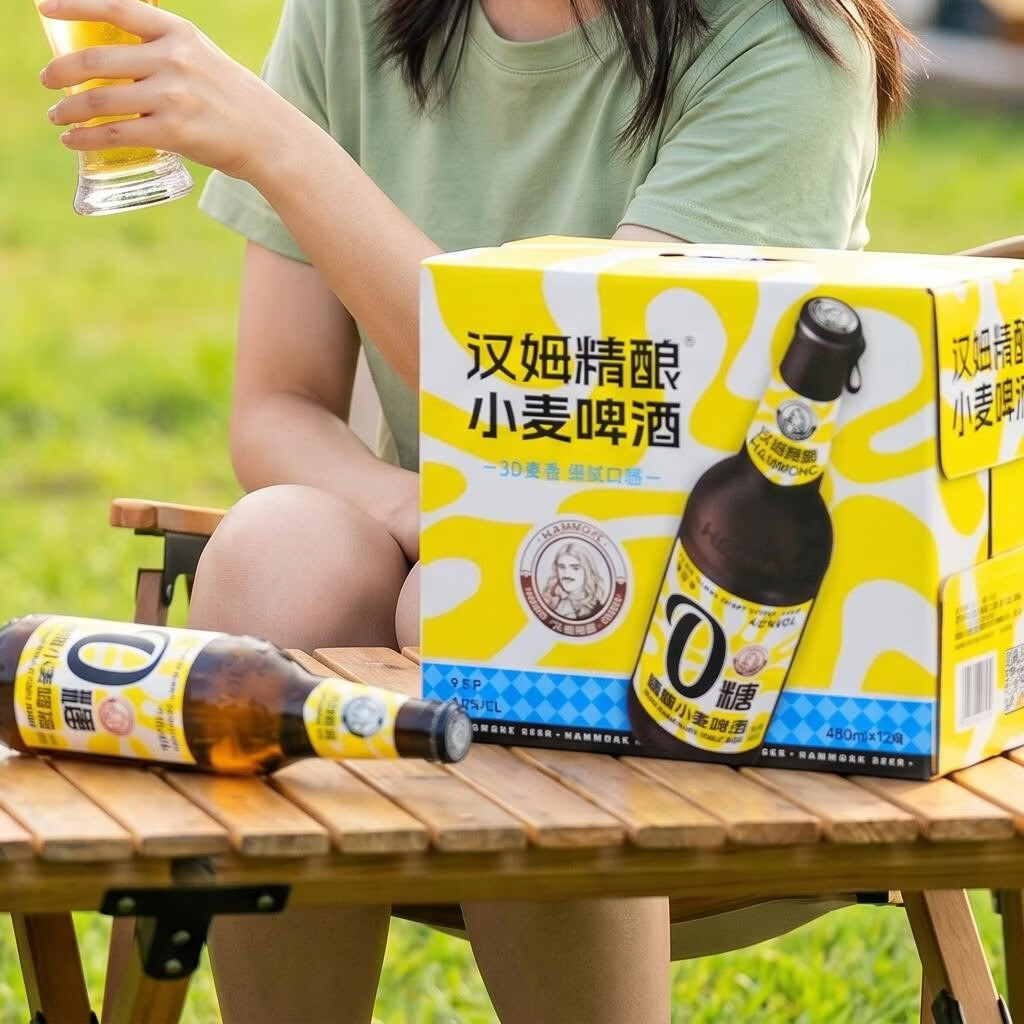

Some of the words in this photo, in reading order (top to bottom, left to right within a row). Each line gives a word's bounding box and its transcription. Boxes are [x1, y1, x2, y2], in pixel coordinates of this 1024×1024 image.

[467, 331, 682, 390] 汉姆精酿
[468, 391, 681, 448] 小麦啤酒
